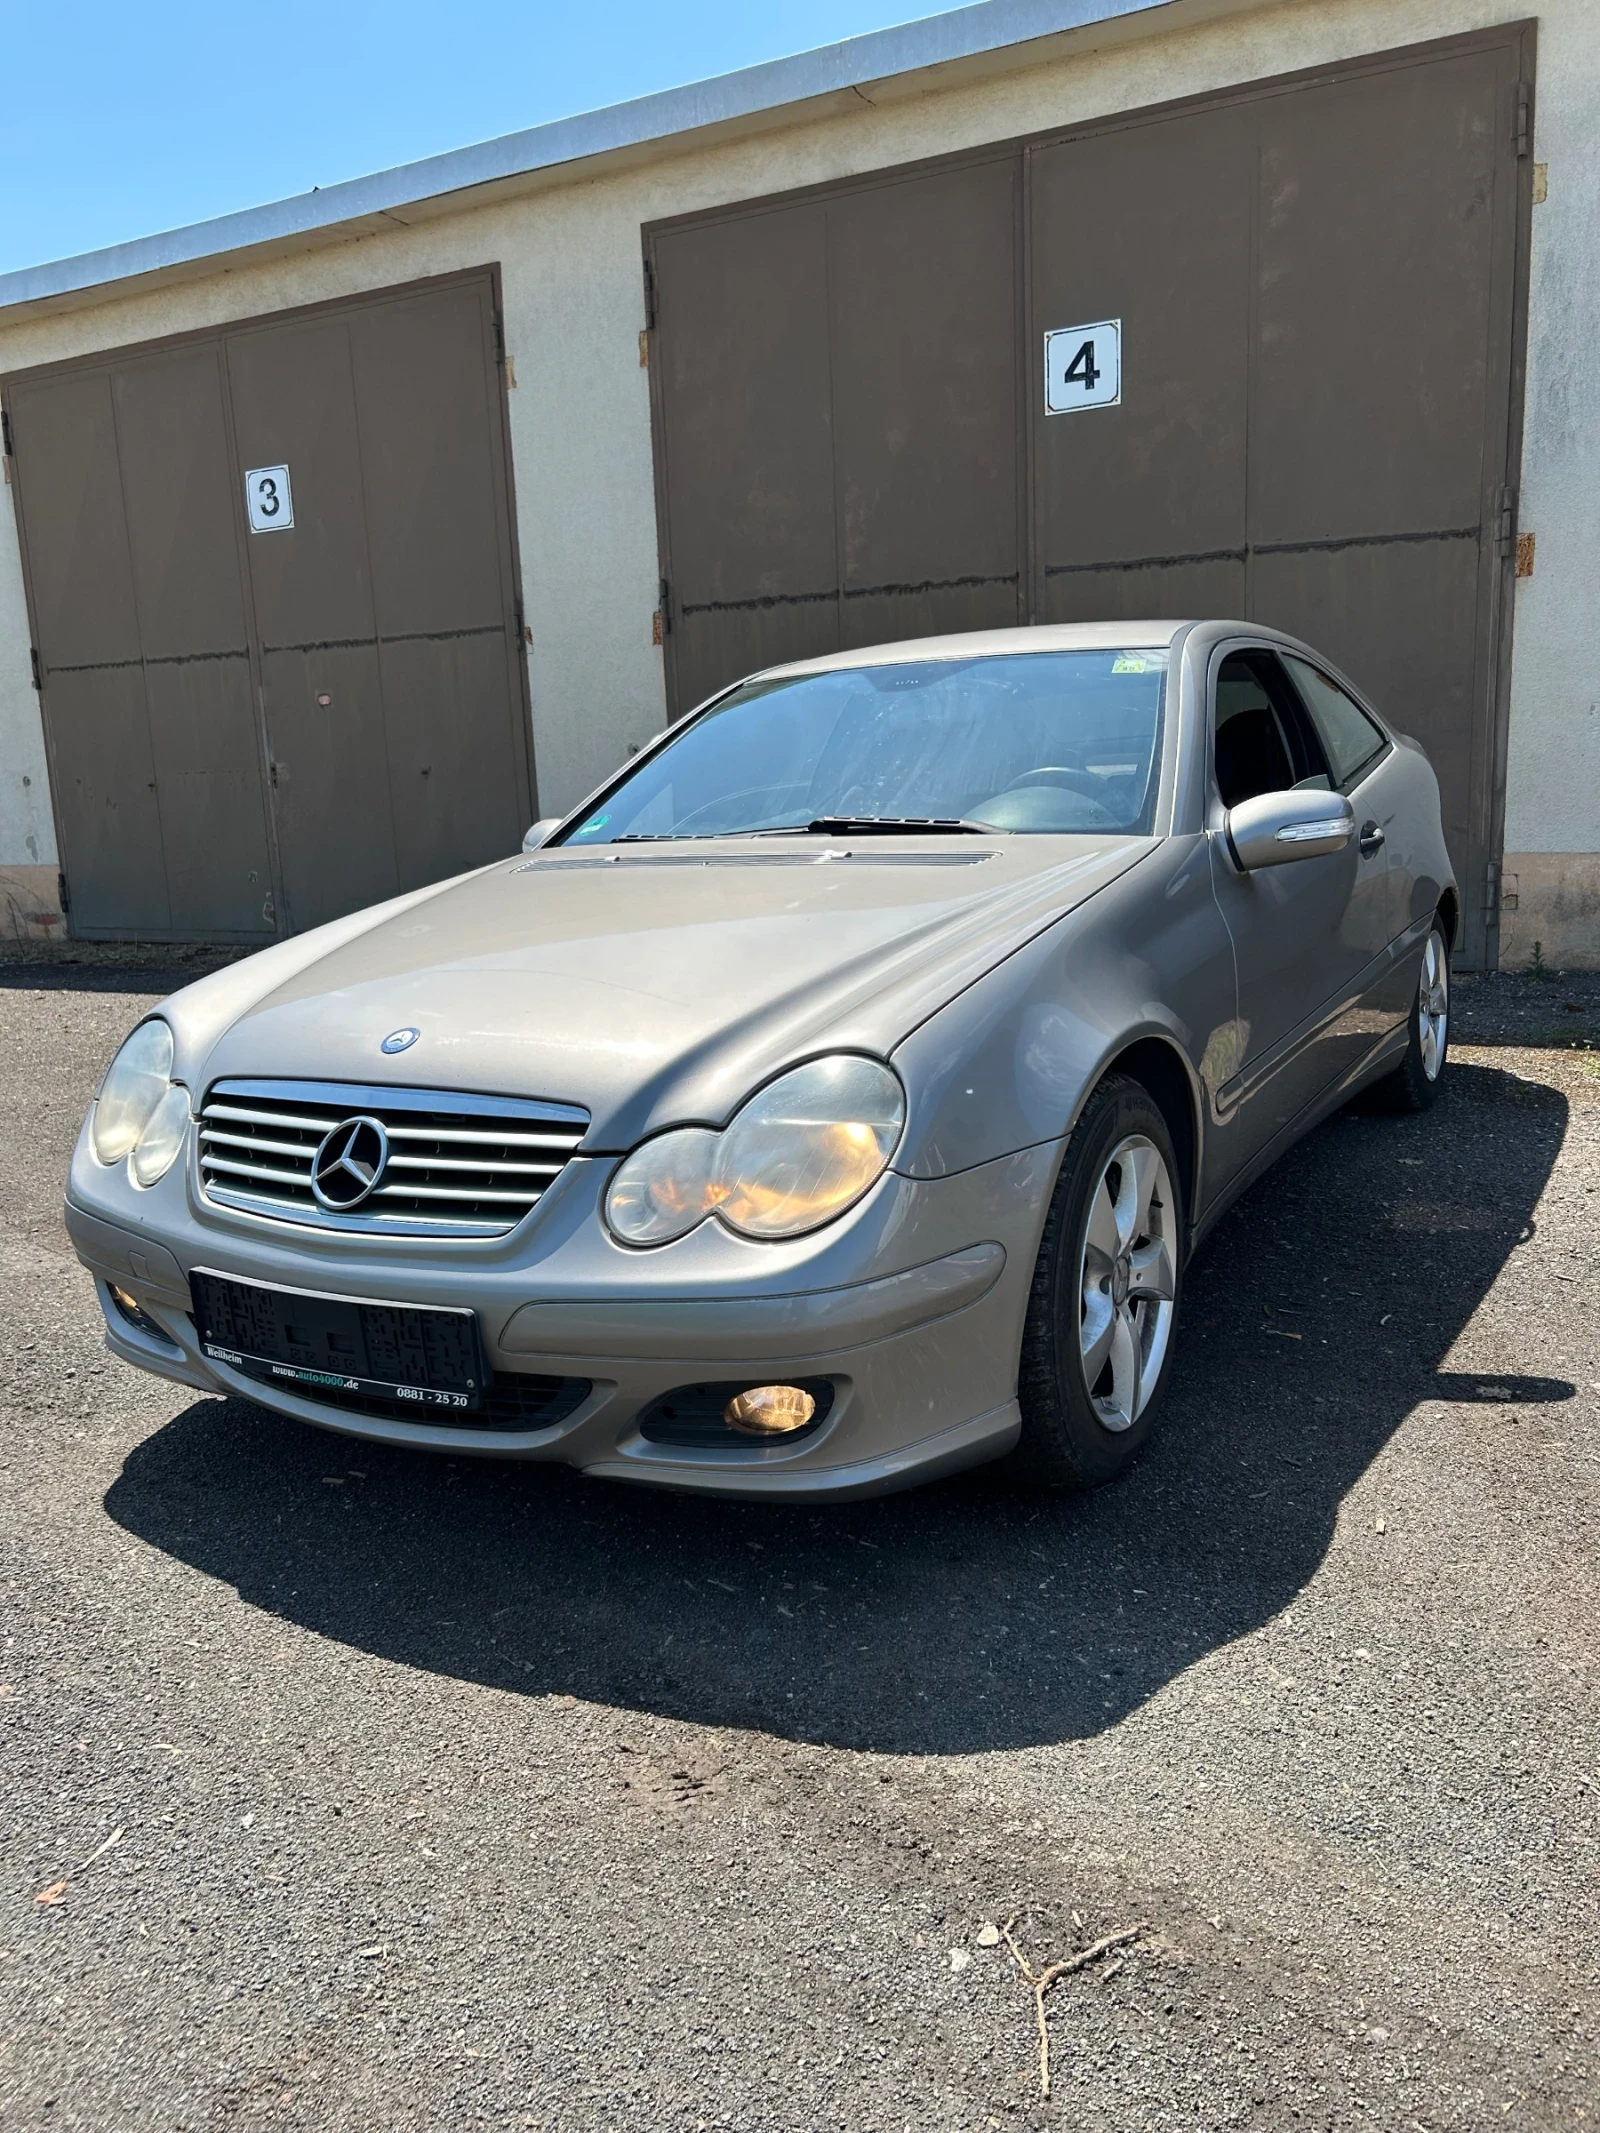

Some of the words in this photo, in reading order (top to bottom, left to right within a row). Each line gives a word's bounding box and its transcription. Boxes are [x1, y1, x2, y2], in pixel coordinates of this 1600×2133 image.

[1064, 340, 1100, 390] 4
[259, 478, 280, 517] 3
[207, 1347, 243, 1365] Weilheim
[272, 1366, 359, 1390] www.auto4000.de
[396, 1387, 425, 1401] 0881
[435, 1393, 450, 1405] 25
[452, 1396, 468, 1408] 20
